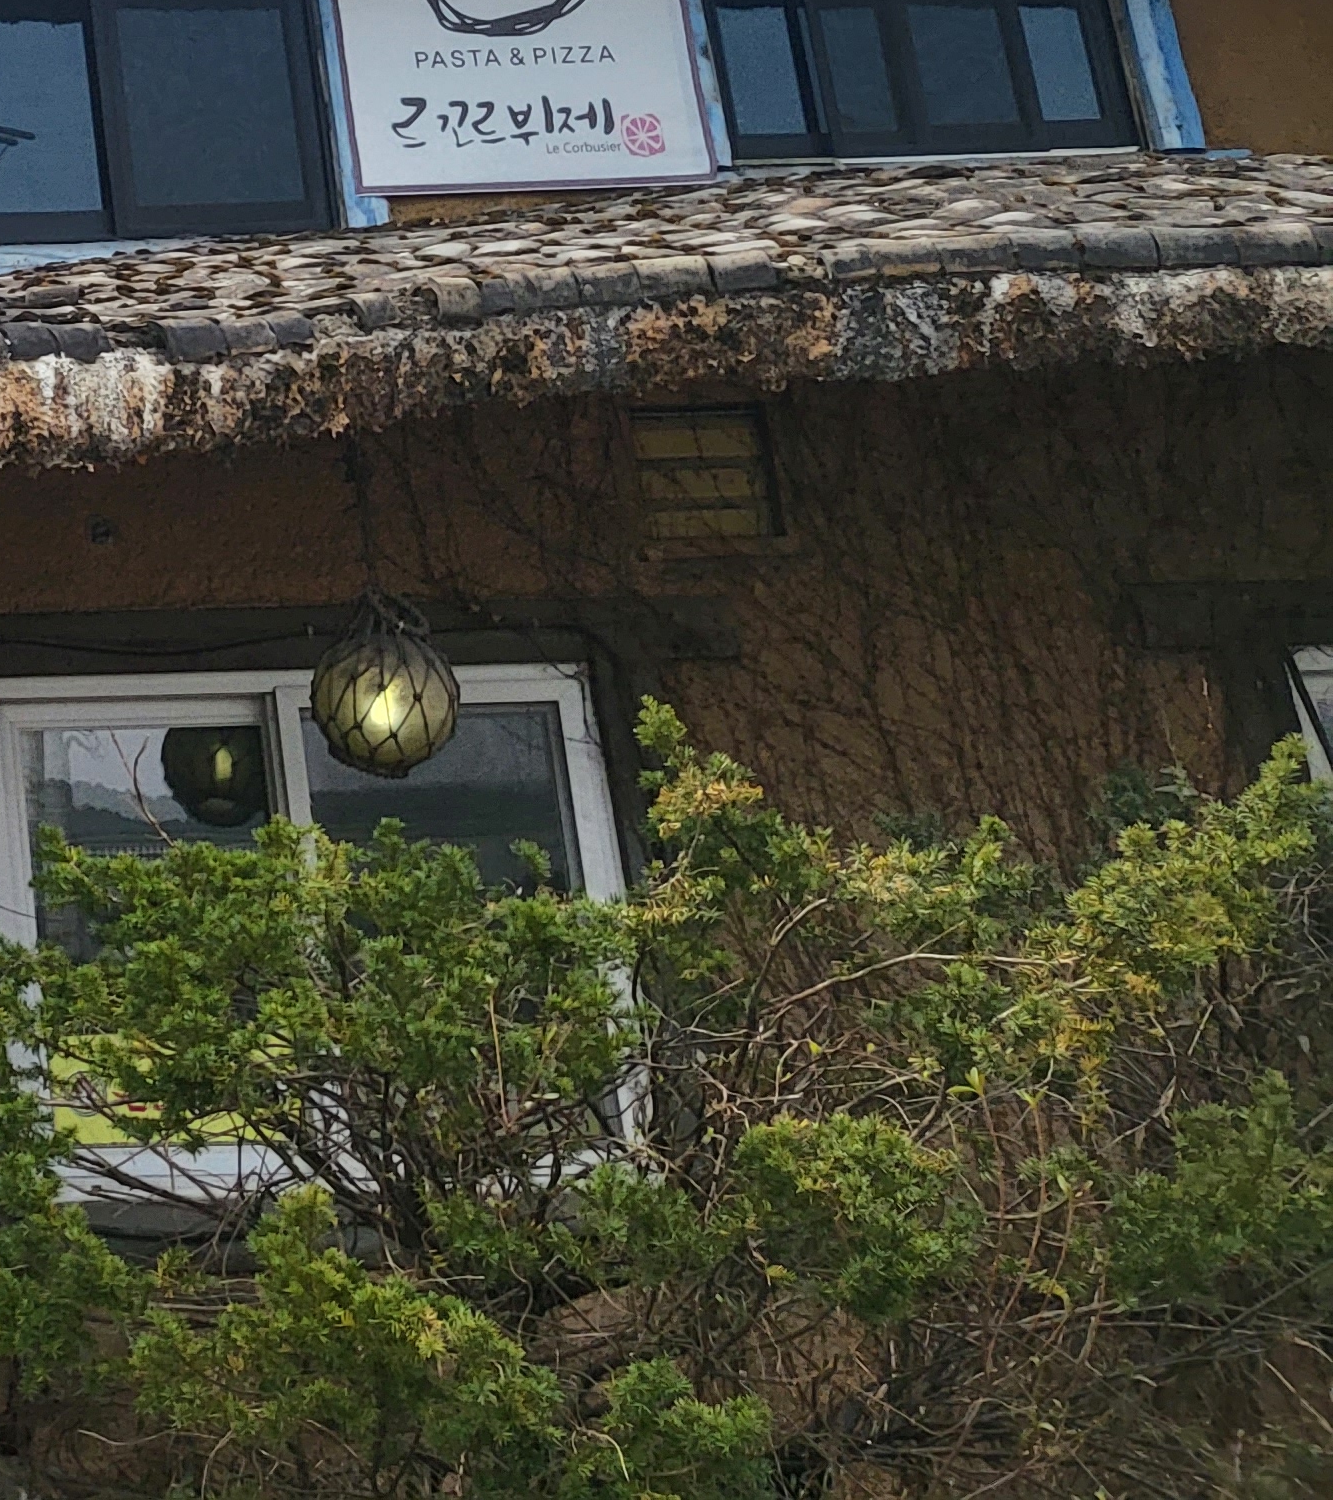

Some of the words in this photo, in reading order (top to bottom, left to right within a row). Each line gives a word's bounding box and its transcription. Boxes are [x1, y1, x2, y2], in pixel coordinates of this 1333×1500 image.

[414, 49, 501, 69] PASTA
[533, 45, 617, 67] PIZZA
[545, 142, 560, 154] Le
[563, 140, 622, 154] Corbusier
